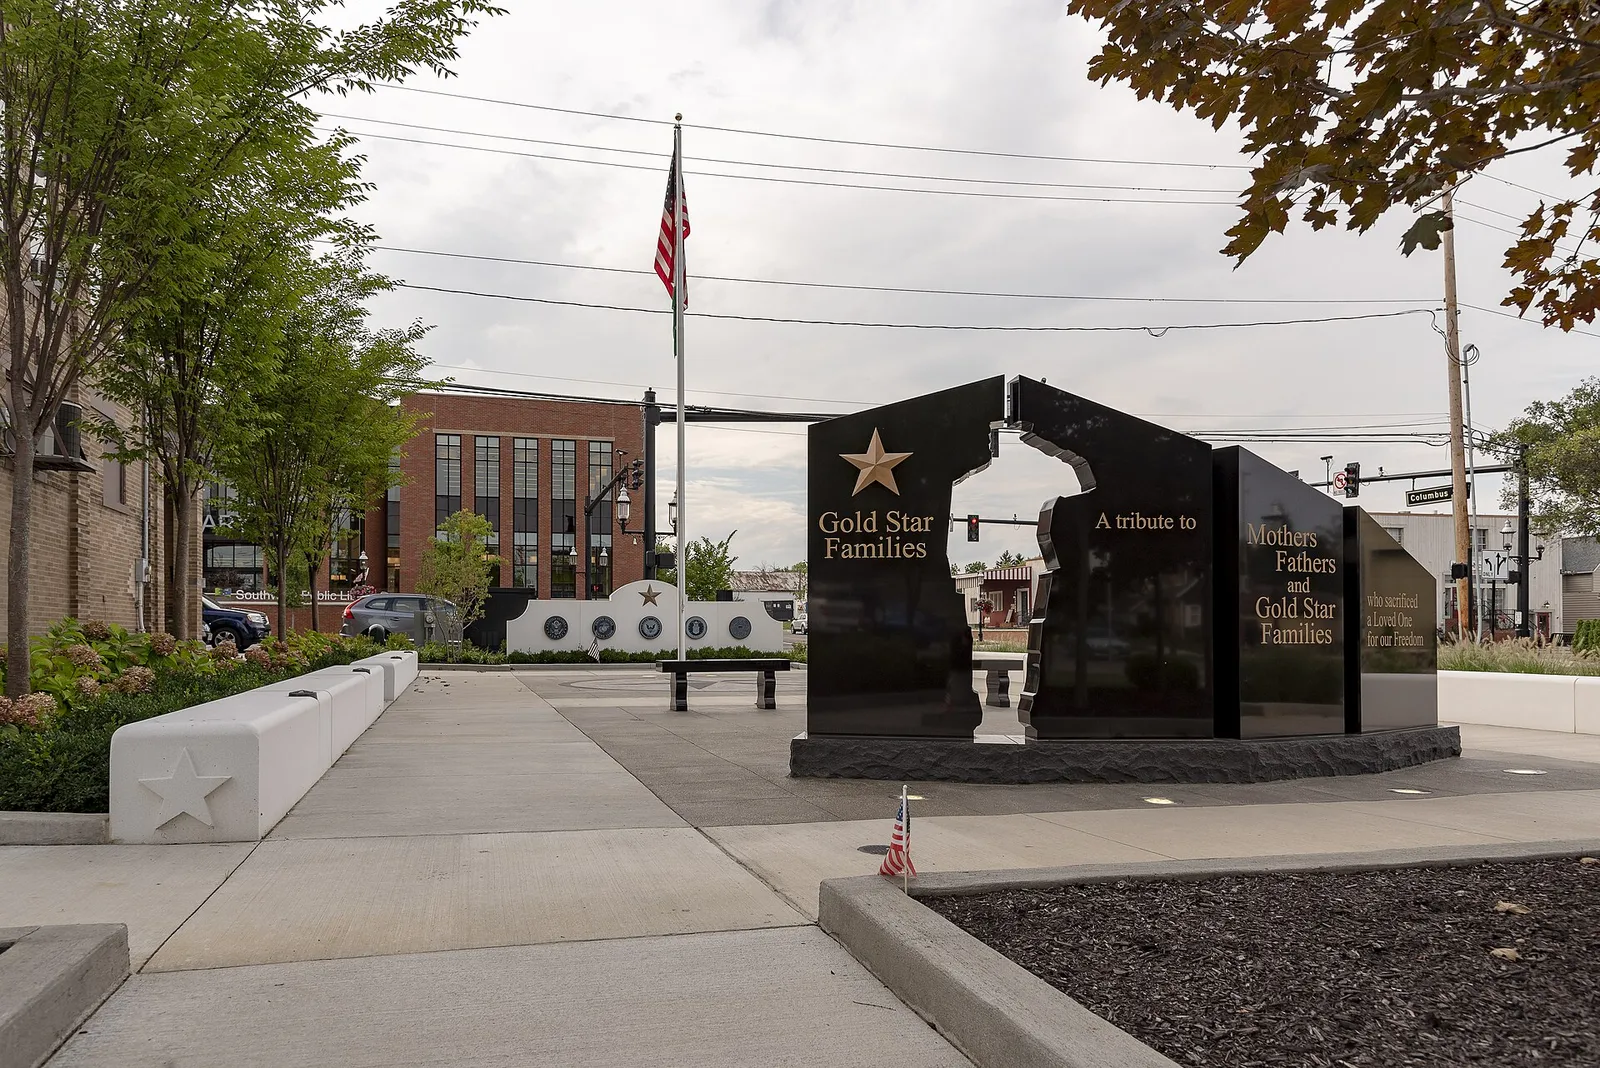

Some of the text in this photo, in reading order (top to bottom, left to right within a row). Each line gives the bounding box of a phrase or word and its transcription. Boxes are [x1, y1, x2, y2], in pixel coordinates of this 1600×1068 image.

[1410, 491, 1449, 501] Columbus
[818, 510, 934, 533] Gold Star
[1095, 512, 1197, 529] A tribute to
[1247, 523, 1318, 548] Mothers
[824, 536, 927, 559] Families
[1275, 550, 1336, 574] Fathers
[1287, 576, 1310, 593] and
[301, 590, 337, 601] Pblic
[1367, 591, 1418, 609] who sacrificed
[1255, 596, 1336, 619] Gold Star
[1367, 611, 1413, 627] a Loved One
[1260, 622, 1333, 645] Families
[1367, 630, 1424, 647] for our Freedom
